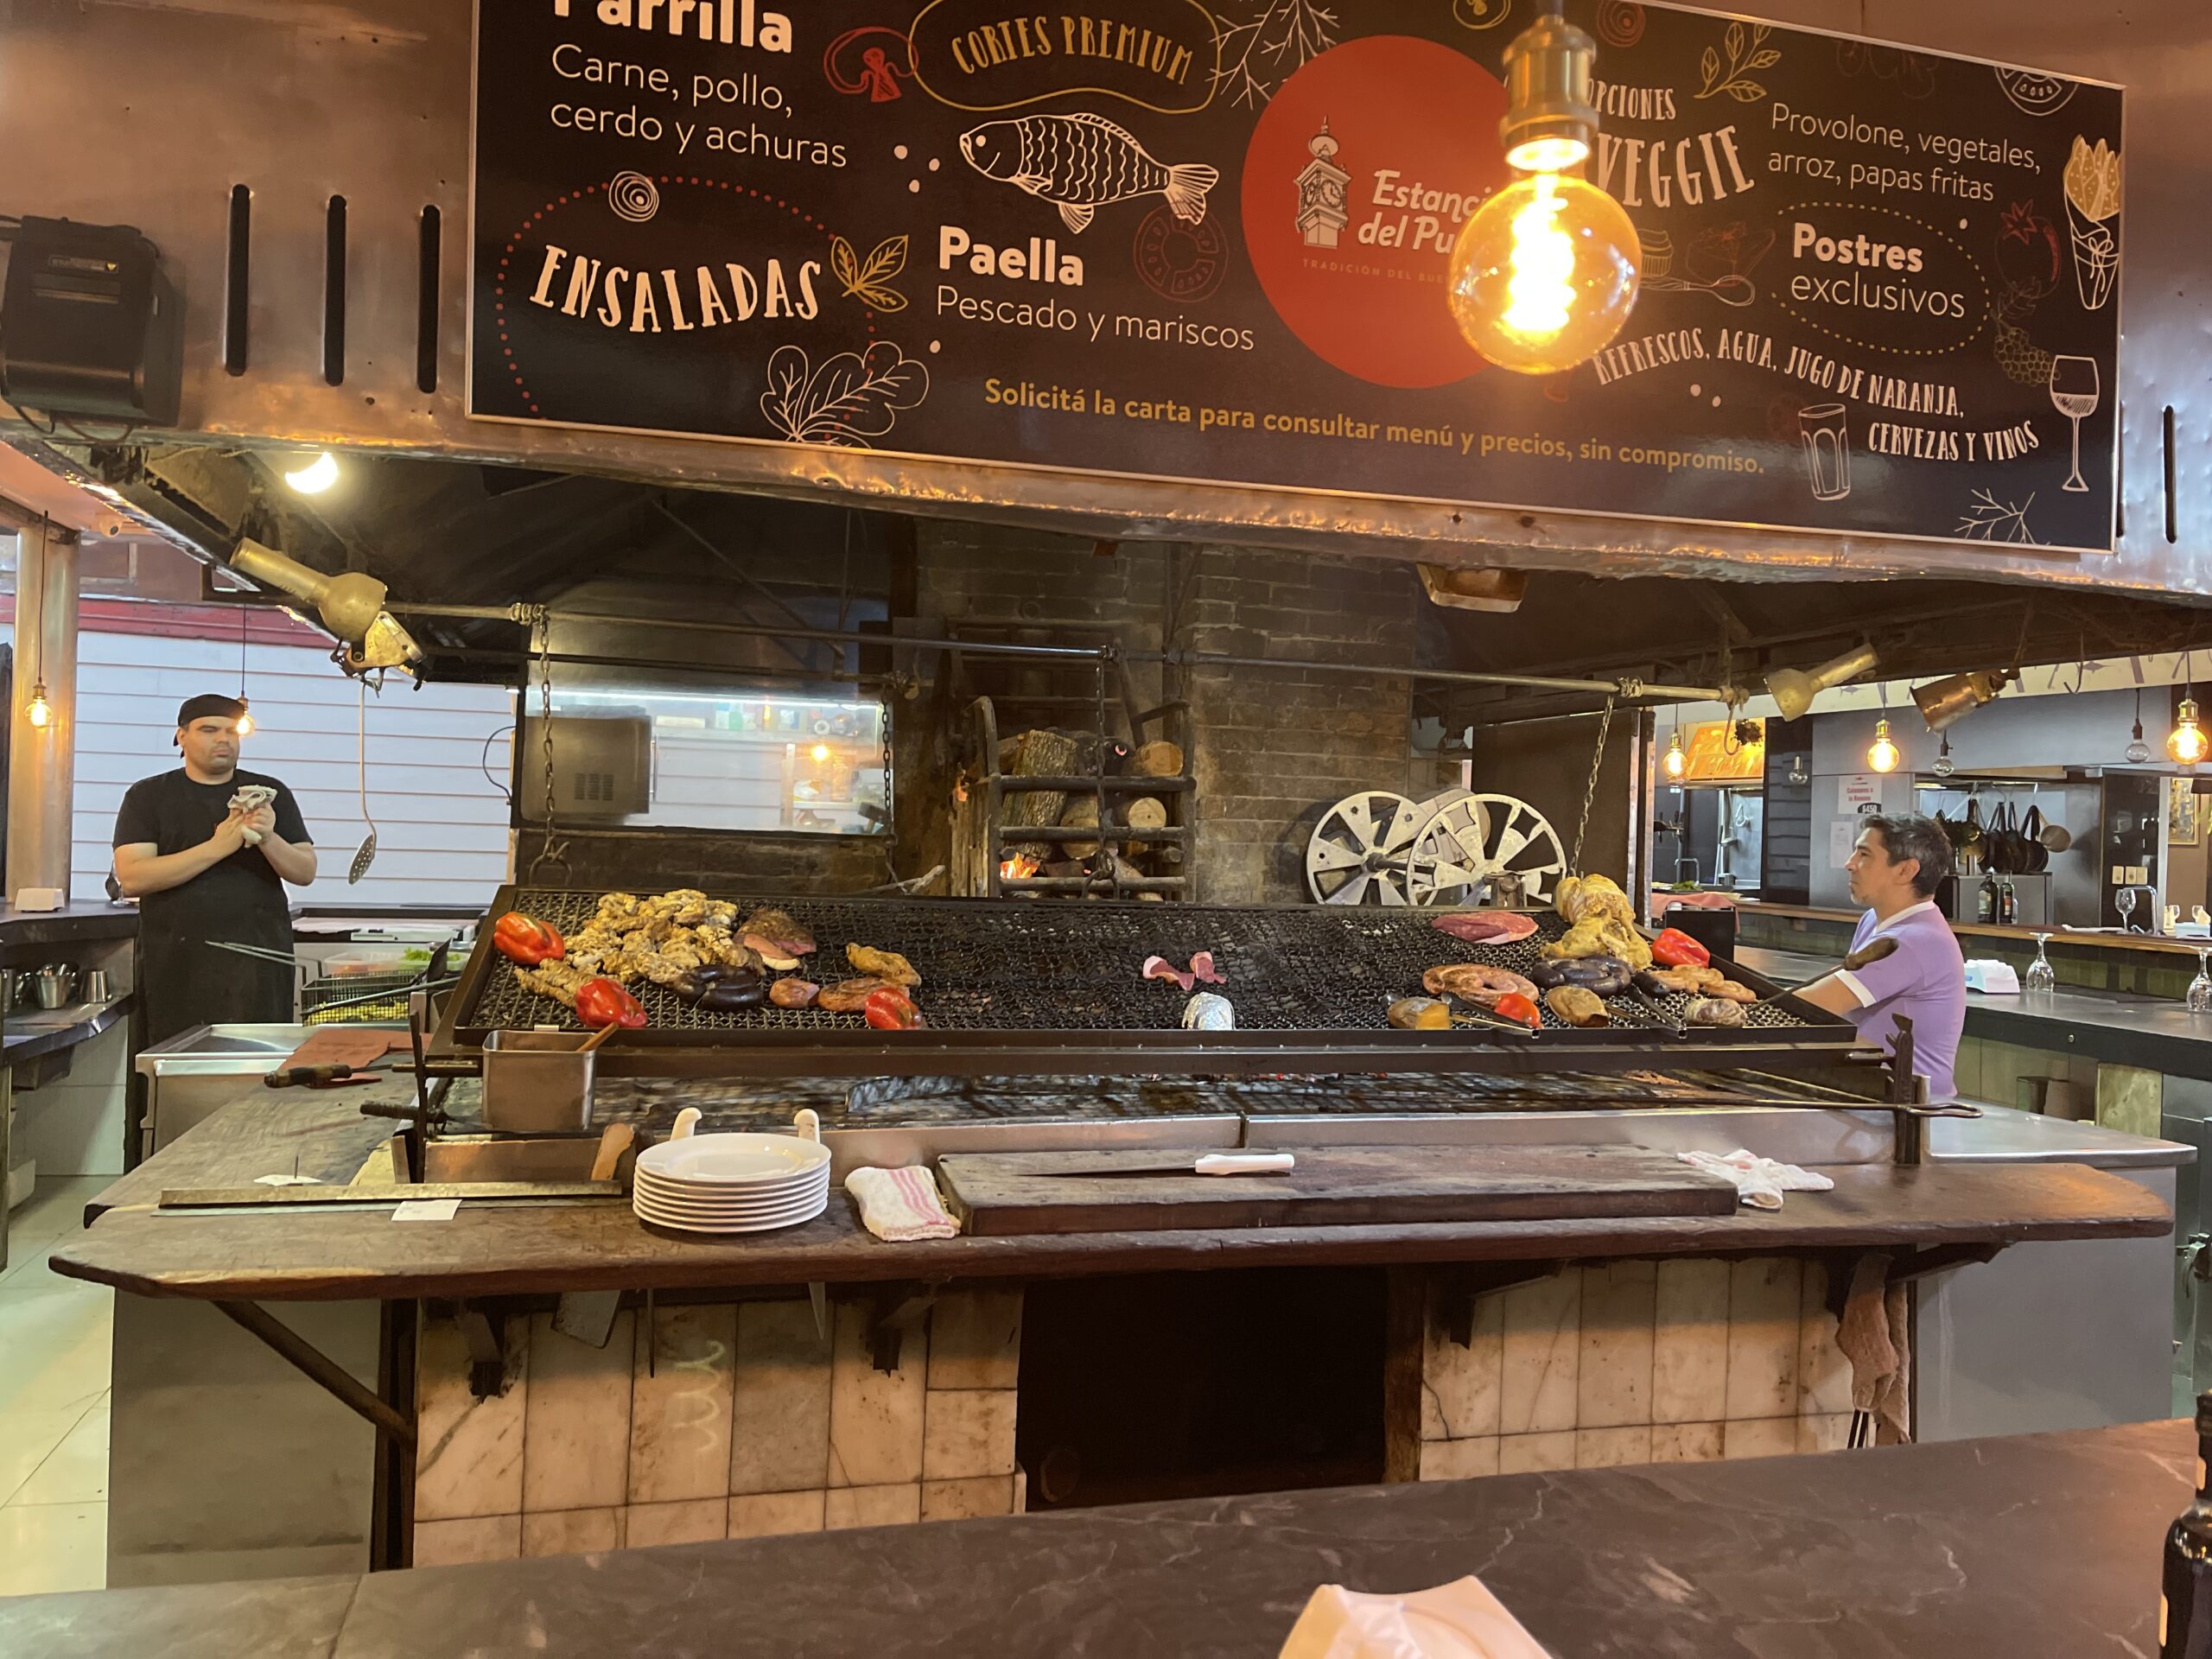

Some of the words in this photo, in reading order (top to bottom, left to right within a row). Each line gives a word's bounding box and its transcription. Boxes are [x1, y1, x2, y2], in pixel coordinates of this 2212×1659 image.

[553, 43, 679, 100] Carne,
[693, 73, 791, 118] pollo,
[951, 16, 1052, 74] CORTES
[1060, 16, 1193, 85] PREMIUM
[1588, 79, 1675, 119] OPCIONES
[550, 103, 663, 141] cerdo
[676, 122, 696, 154] y
[707, 122, 846, 167] achuras
[1598, 125, 1754, 207] VEGGIE
[1771, 102, 1911, 156] Provolone,
[1918, 131, 2041, 175] vegetales,
[1372, 169, 1491, 223] Estanc
[1768, 151, 1840, 186] arroz,
[1851, 164, 1923, 194] papas
[1931, 167, 1993, 201] fritas
[939, 226, 1084, 286] Paella
[1358, 212, 1408, 247] del
[1794, 222, 1923, 272] Postres
[530, 245, 821, 333] ENSALADAS
[1303, 258, 1380, 276] TRADICIÓN
[1388, 270, 1411, 279] DEL
[1791, 270, 1964, 318] exclusivos
[938, 286, 1077, 330] Pescado
[1088, 312, 1105, 341] y
[1116, 315, 1254, 351] mariscos
[1592, 327, 1710, 385] REFRESCOS,
[1718, 328, 1777, 372] AGUA,
[1784, 346, 1834, 389] JUGO
[1838, 365, 1864, 399] DE
[1867, 375, 1964, 417] NARANJA,
[986, 378, 1085, 413] Solicitá
[1095, 391, 1116, 415] la
[1124, 397, 1192, 423] carta
[1200, 406, 1255, 430] para
[1263, 412, 1380, 441] consultar
[1387, 423, 1452, 447] menú
[1460, 434, 1474, 454] y
[1481, 432, 1572, 461] precios,
[1580, 438, 1611, 461] sin
[1618, 447, 1764, 473] compromiso.
[1868, 423, 1960, 461] CERVEZAS
[1966, 431, 1977, 462] Y
[1983, 421, 2039, 461] VINOS
